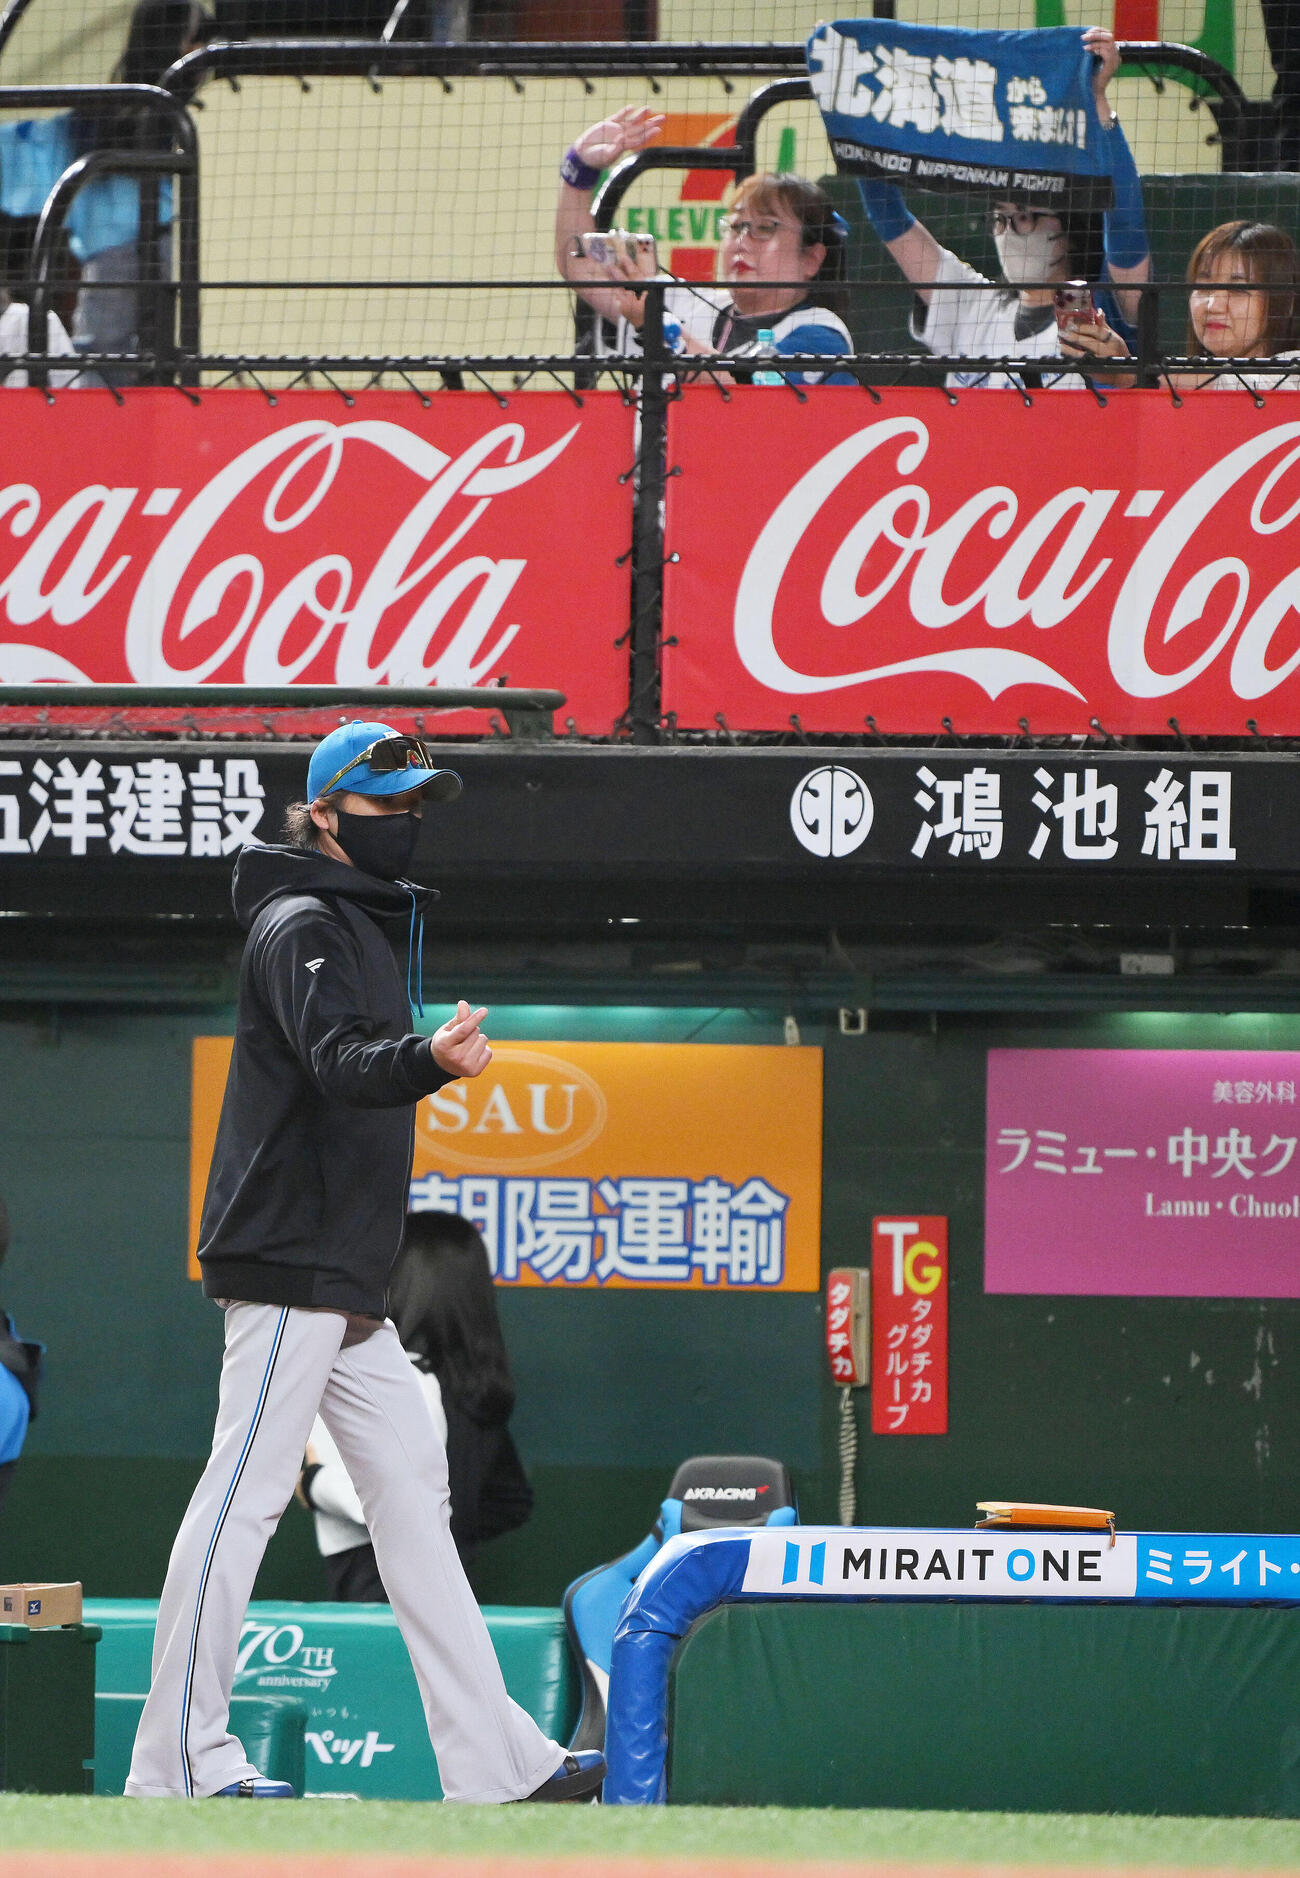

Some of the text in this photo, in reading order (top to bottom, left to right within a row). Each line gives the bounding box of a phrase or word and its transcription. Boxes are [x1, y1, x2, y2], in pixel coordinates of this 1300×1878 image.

[811, 26, 1003, 142] 北海道
[1006, 76, 1047, 105] から
[916, 159, 1008, 189] NIPPONHAM
[911, 765, 1237, 861] 鴻池組
[427, 1083, 580, 1137] SAU
[1212, 1080, 1296, 1104] 美容外科
[997, 1126, 1298, 1180] ラミュー・中央ク
[409, 1172, 790, 1285] 朝陽運輸
[877, 1221, 942, 1296] TG
[829, 1282, 853, 1377] タダチカ
[911, 1298, 933, 1404] タダチカ
[886, 1323, 910, 1430] グループ
[683, 1487, 757, 1501] AKRACING
[842, 1548, 1101, 1582] MIRAIT ONE
[257, 1674, 333, 1693] anniversary
